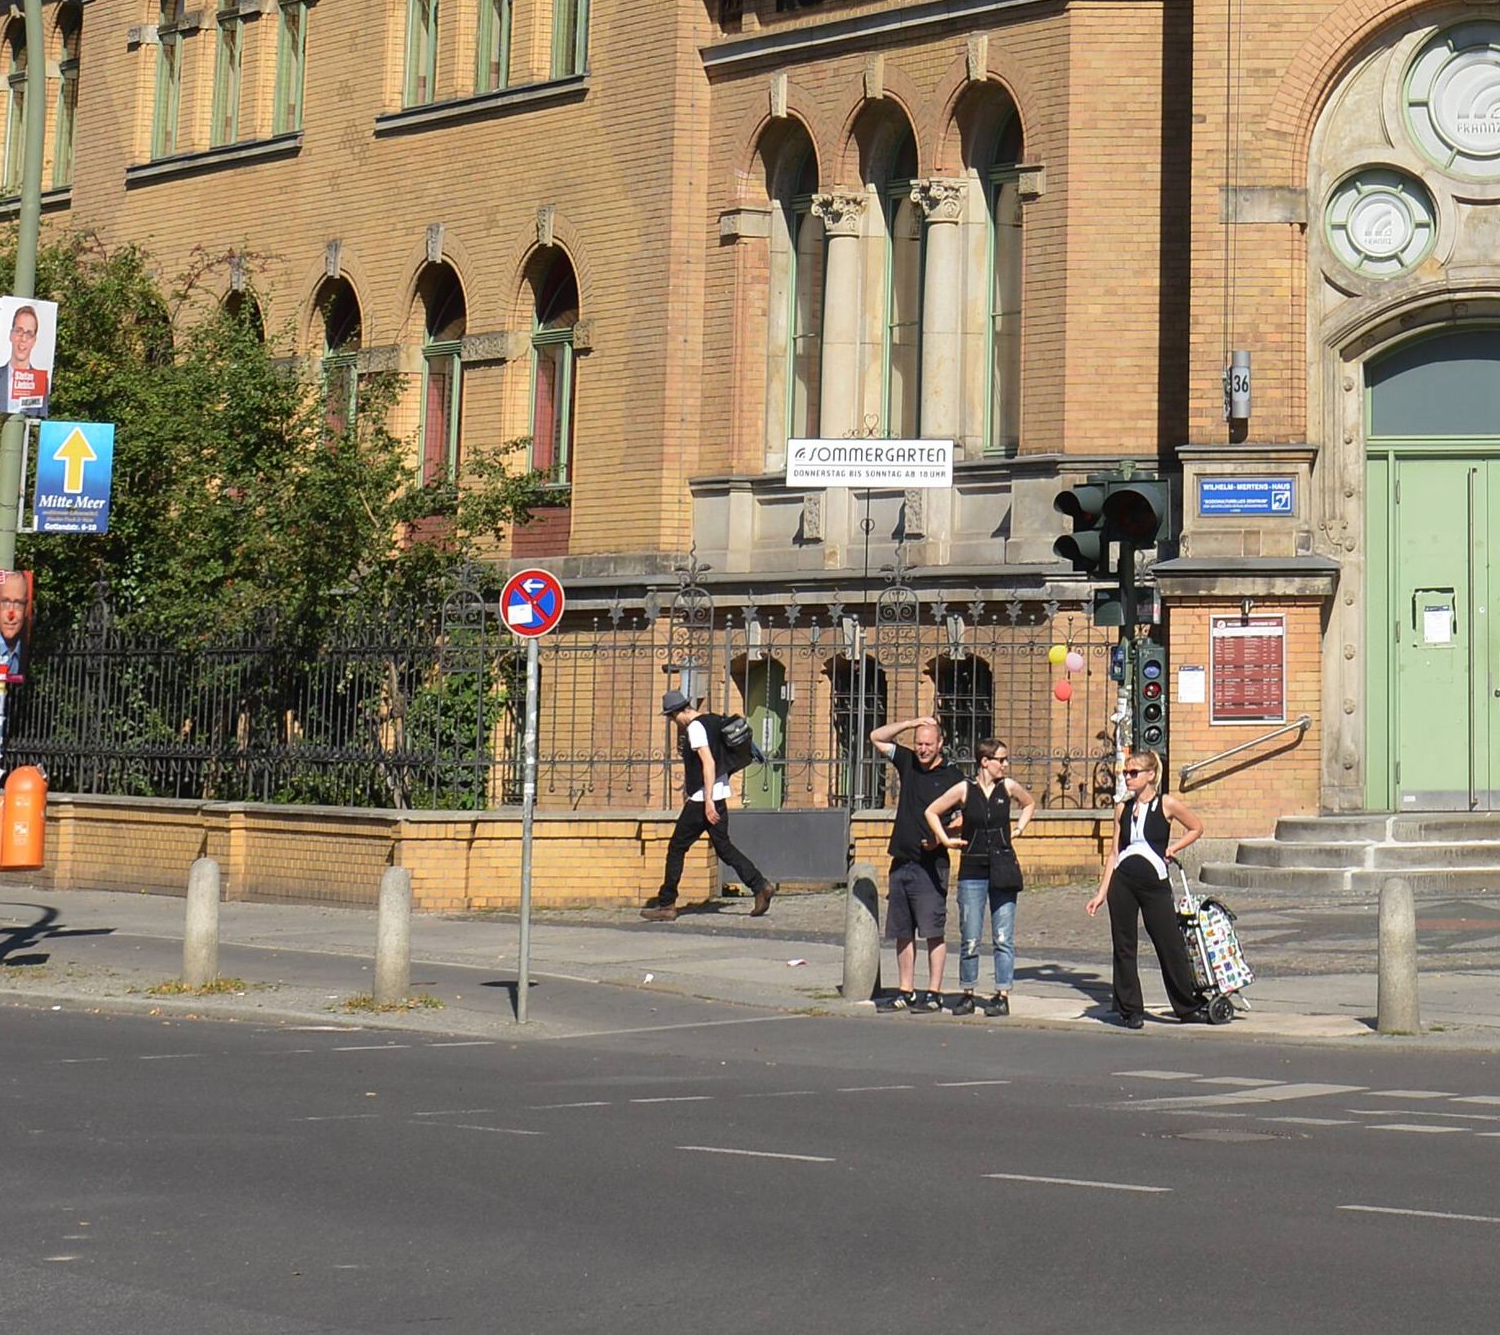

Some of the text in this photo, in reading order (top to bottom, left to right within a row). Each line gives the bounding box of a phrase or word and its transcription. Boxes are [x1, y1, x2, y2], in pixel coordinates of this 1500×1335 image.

[1233, 374, 1249, 393] 36
[808, 446, 947, 463] SOMMERGARTEN
[793, 469, 847, 478] DONNERSTAG
[849, 469, 862, 478] BIS
[865, 470, 903, 478] SONNTAG
[904, 470, 916, 478] AB
[38, 494, 106, 510] Mitte Meer
